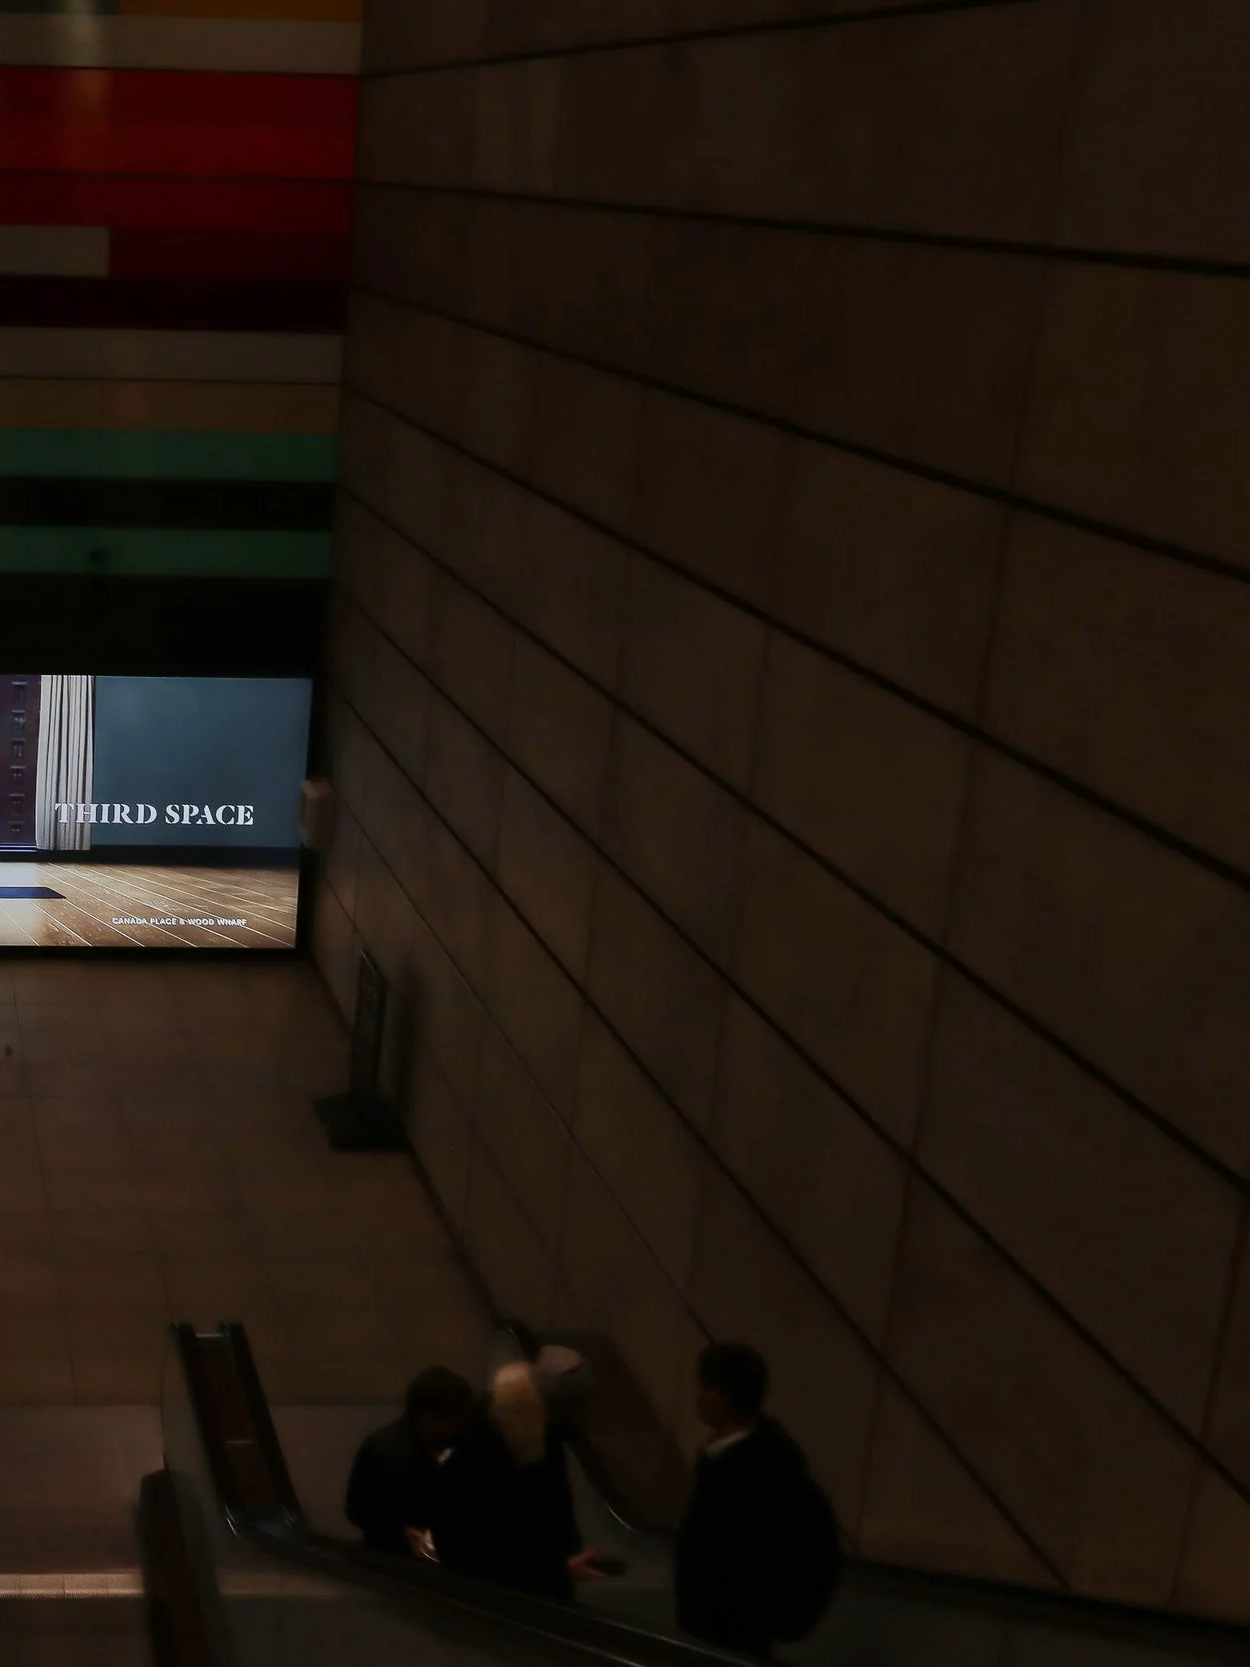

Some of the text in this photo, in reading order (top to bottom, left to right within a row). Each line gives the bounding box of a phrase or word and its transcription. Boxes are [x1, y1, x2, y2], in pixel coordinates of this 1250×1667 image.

[54, 803, 254, 826] THIRD SPACE
[112, 917, 148, 925] CANADA
[150, 917, 177, 926] PLACE
[187, 918, 215, 926] WOOD
[217, 918, 247, 927] WHARF
